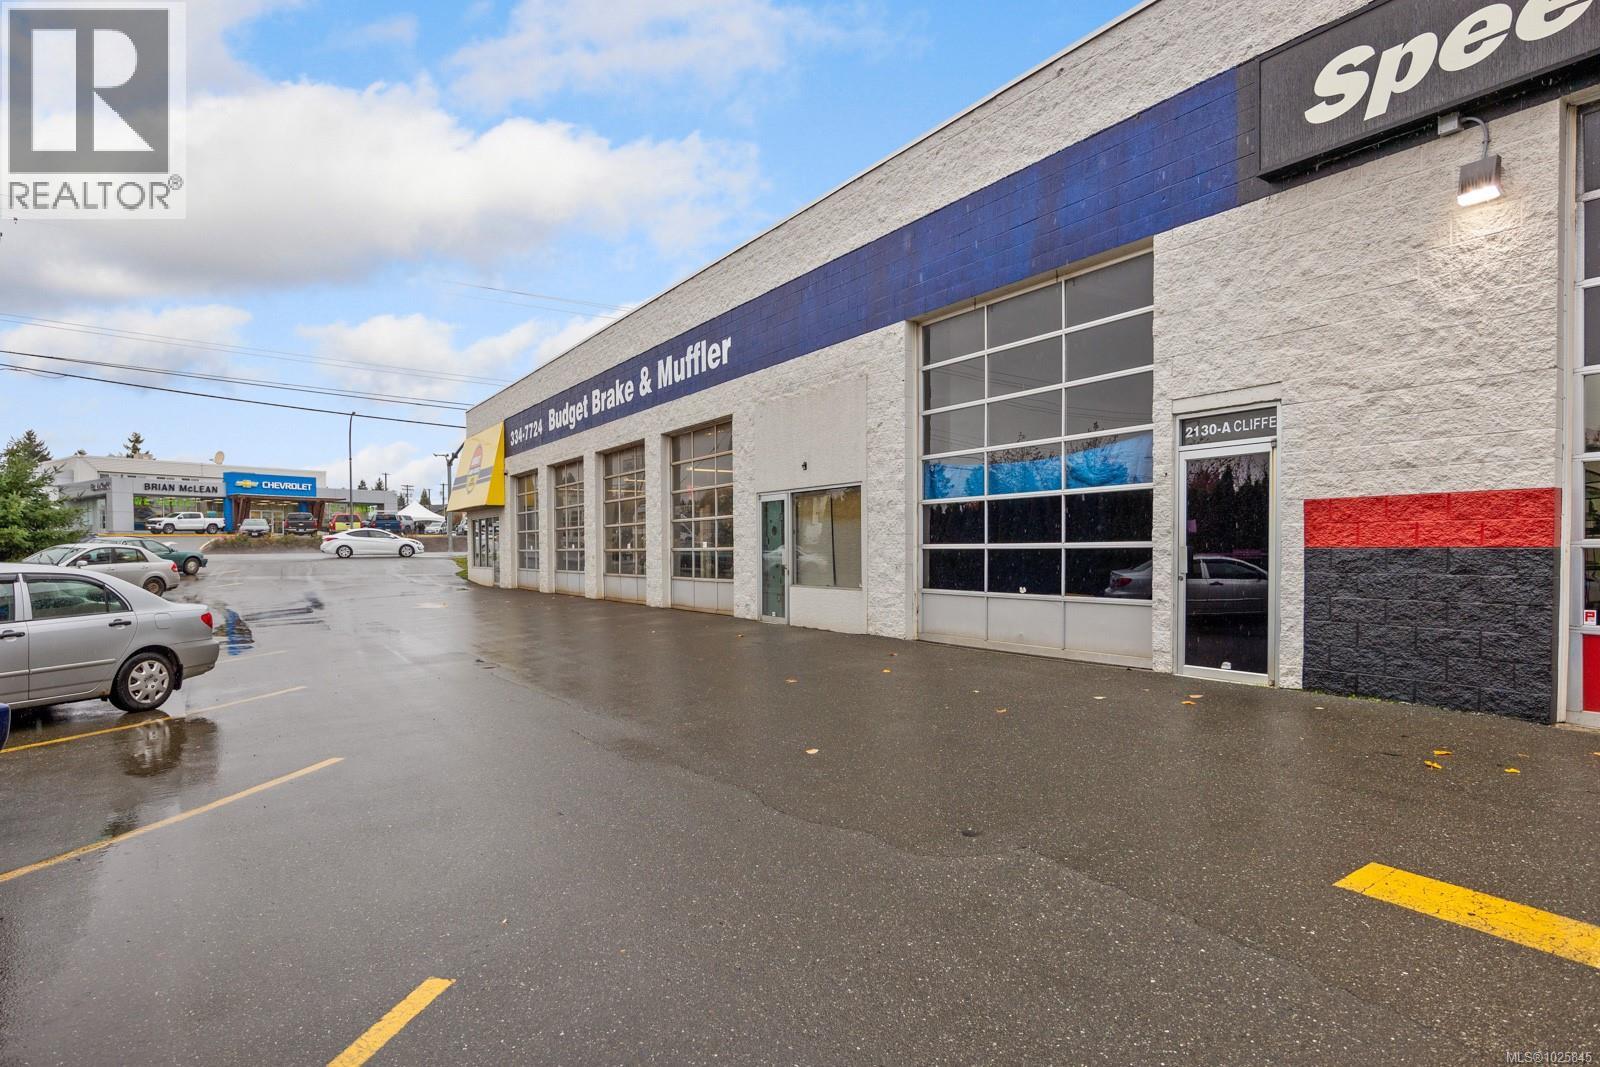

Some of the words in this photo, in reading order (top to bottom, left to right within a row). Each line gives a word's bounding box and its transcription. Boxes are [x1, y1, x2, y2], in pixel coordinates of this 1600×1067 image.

[510, 418, 543, 446] 334-7724
[548, 394, 588, 432] Budget
[592, 379, 634, 415] Brake
[639, 366, 652, 397] &
[657, 336, 732, 390] Muffler
[1185, 422, 1231, 438] 2130-A
[1233, 416, 1277, 432] CLIFFE
[144, 482, 175, 492] BRIAN
[179, 484, 218, 494] McLEAN
[262, 481, 312, 491] CHEVROLET
